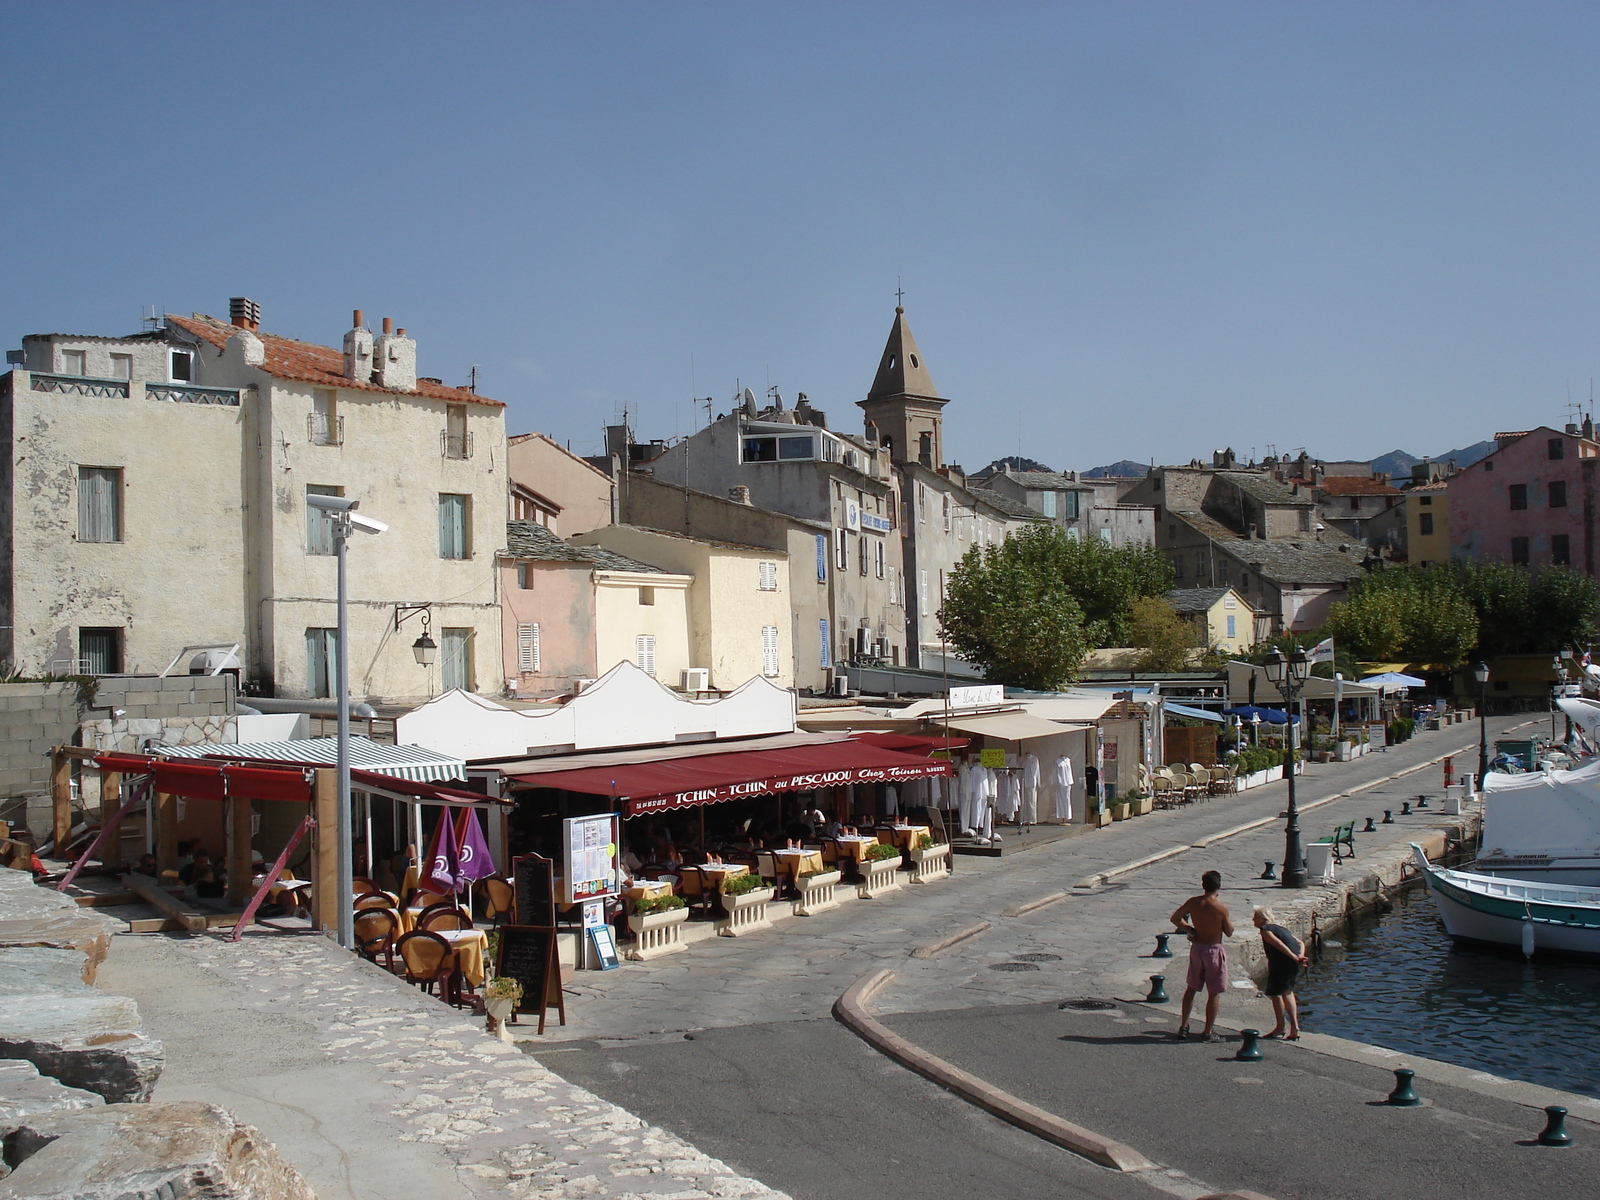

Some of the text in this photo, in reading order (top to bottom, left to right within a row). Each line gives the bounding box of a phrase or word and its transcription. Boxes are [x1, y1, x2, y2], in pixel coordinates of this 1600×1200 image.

[675, 787, 718, 804] TCHIN
[729, 780, 768, 796] TCHIN
[774, 781, 788, 789] au
[790, 770, 852, 787] PESCADOU
[858, 768, 886, 779] Chez
[887, 766, 922, 777] Toinou
